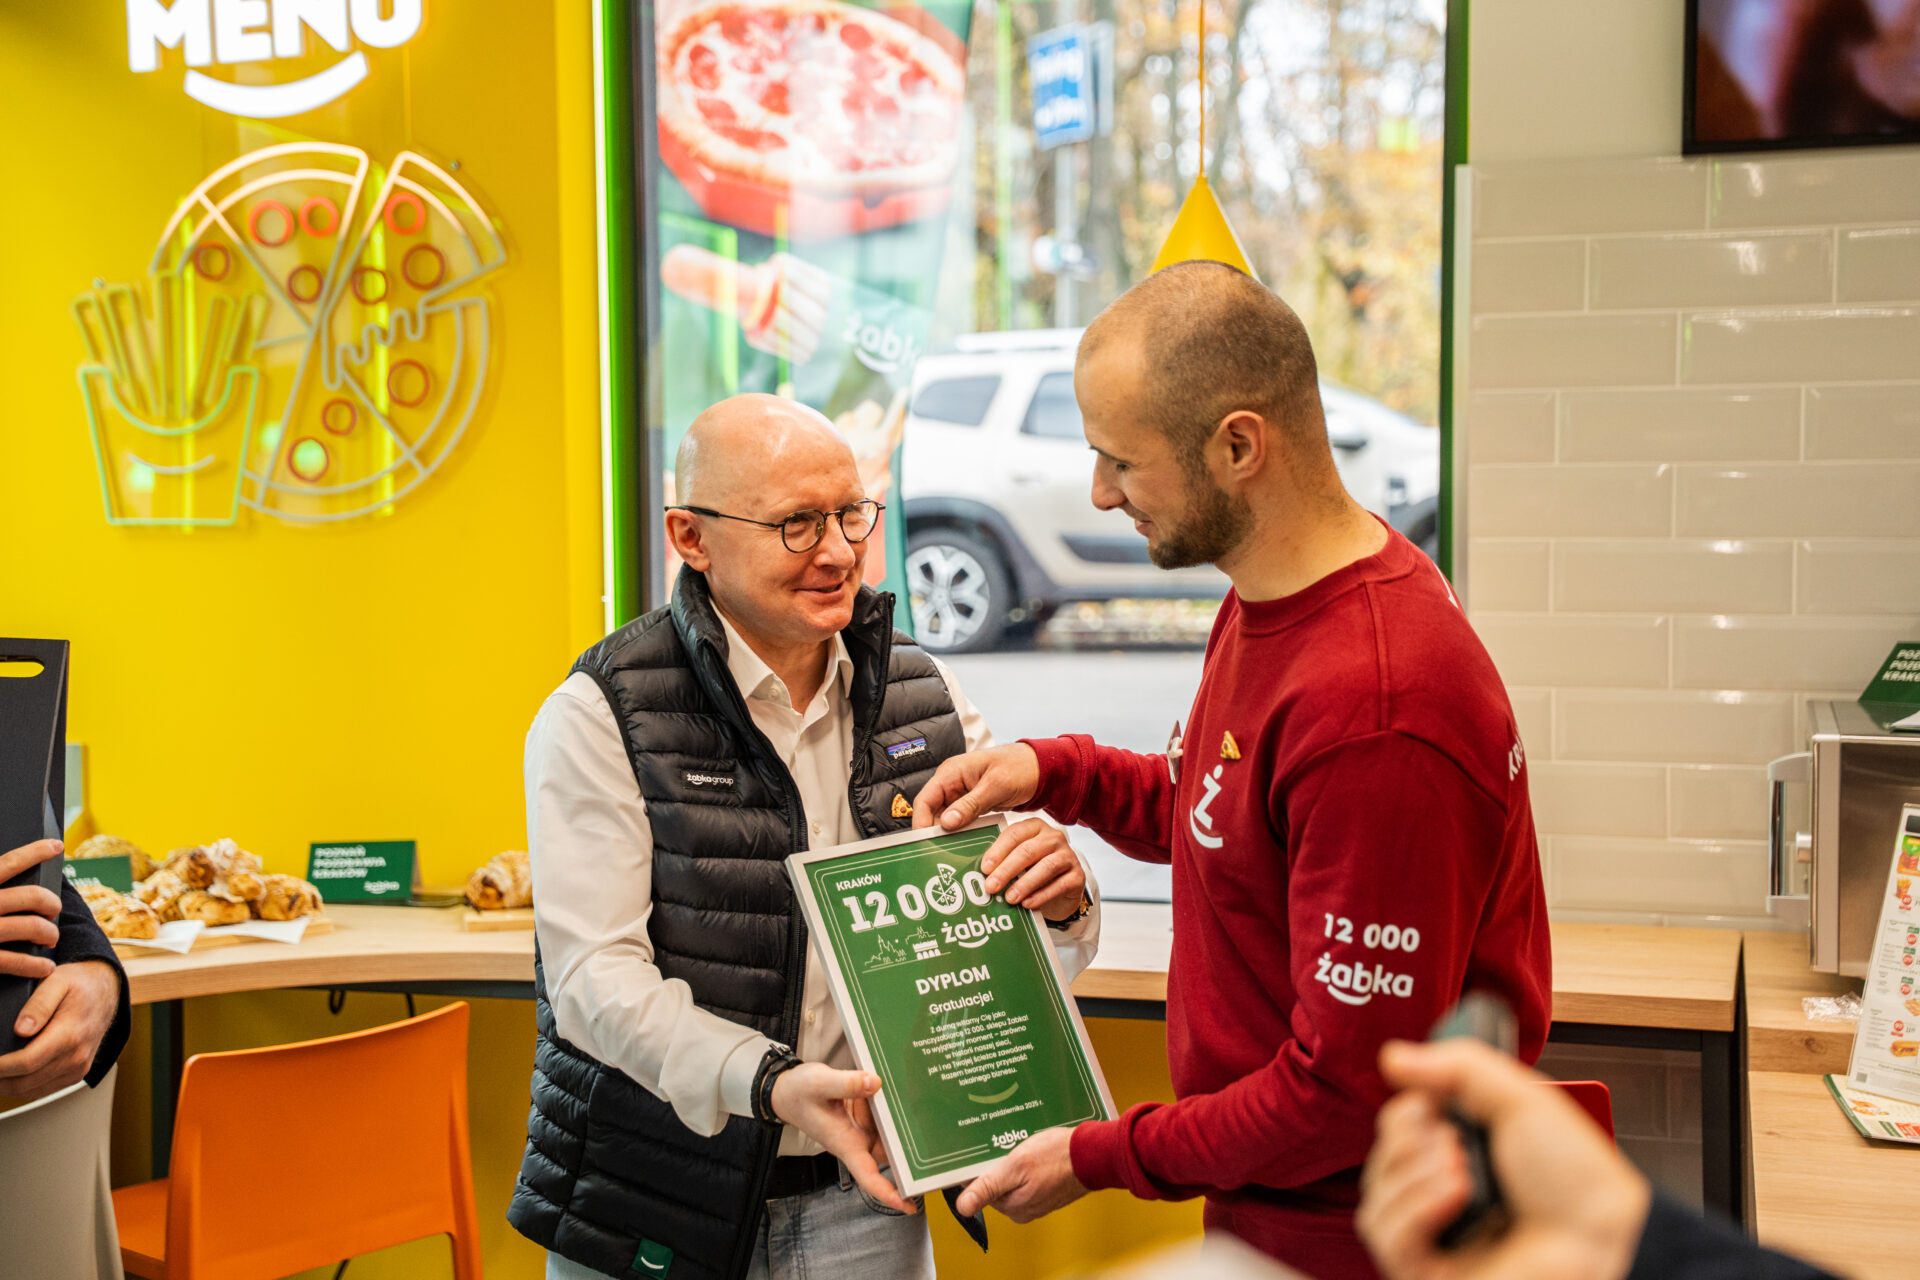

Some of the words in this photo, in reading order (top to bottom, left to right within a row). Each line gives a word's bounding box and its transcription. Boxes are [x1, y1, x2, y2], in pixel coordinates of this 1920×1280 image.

[126, 0, 422, 73] MENU
[835, 873, 882, 891] KRAKÓW
[842, 891, 898, 933] 12
[941, 914, 1014, 945] żabka
[1324, 912, 1353, 944] 12
[1363, 923, 1420, 952] 000
[915, 964, 991, 995] DYPLOM
[1314, 952, 1414, 1000] żabka
[929, 991, 994, 1014] Gratulacje!
[992, 1011, 1006, 1021] jako
[964, 1027, 972, 1035] 12
[987, 1021, 1007, 1031] sklepu
[922, 1048, 931, 1056] To
[966, 1033, 994, 1044] moment
[974, 1042, 996, 1053] naszej
[941, 1070, 964, 1080] Razem
[964, 1062, 995, 1075] tworzymy
[942, 1062, 952, 1070] na
[952, 1057, 974, 1069] Twojej
[959, 1074, 991, 1086] lokalnego
[991, 1129, 1028, 1148] żabka
